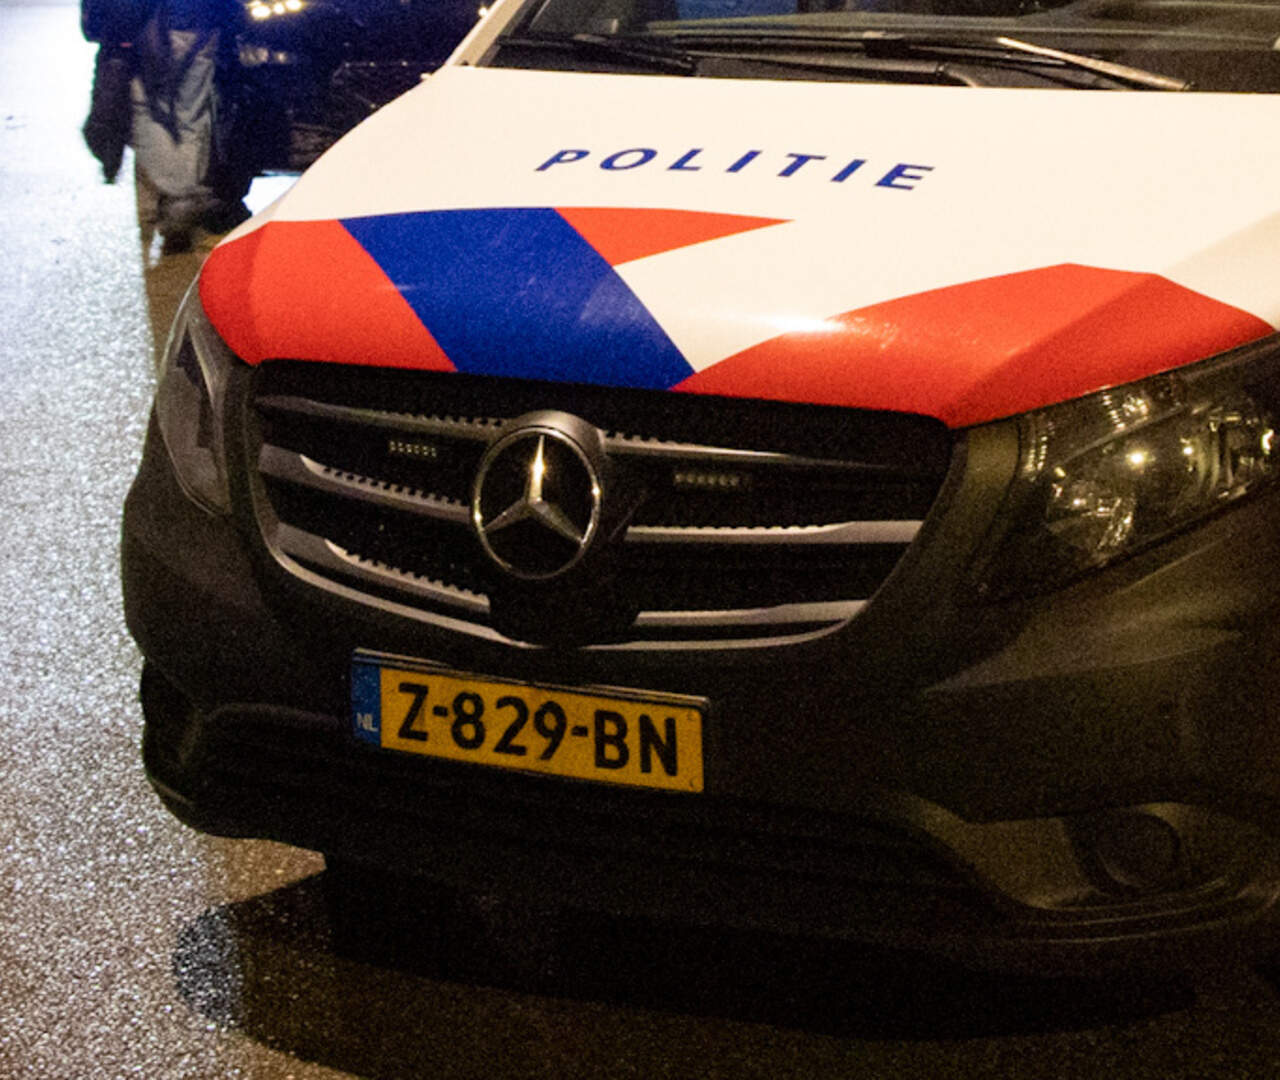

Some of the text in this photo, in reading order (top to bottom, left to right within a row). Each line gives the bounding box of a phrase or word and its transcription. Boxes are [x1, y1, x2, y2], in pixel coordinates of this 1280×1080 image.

[534, 148, 935, 190] POLITIE
[356, 712, 379, 733] NL
[397, 681, 679, 777] Z-829-BN
